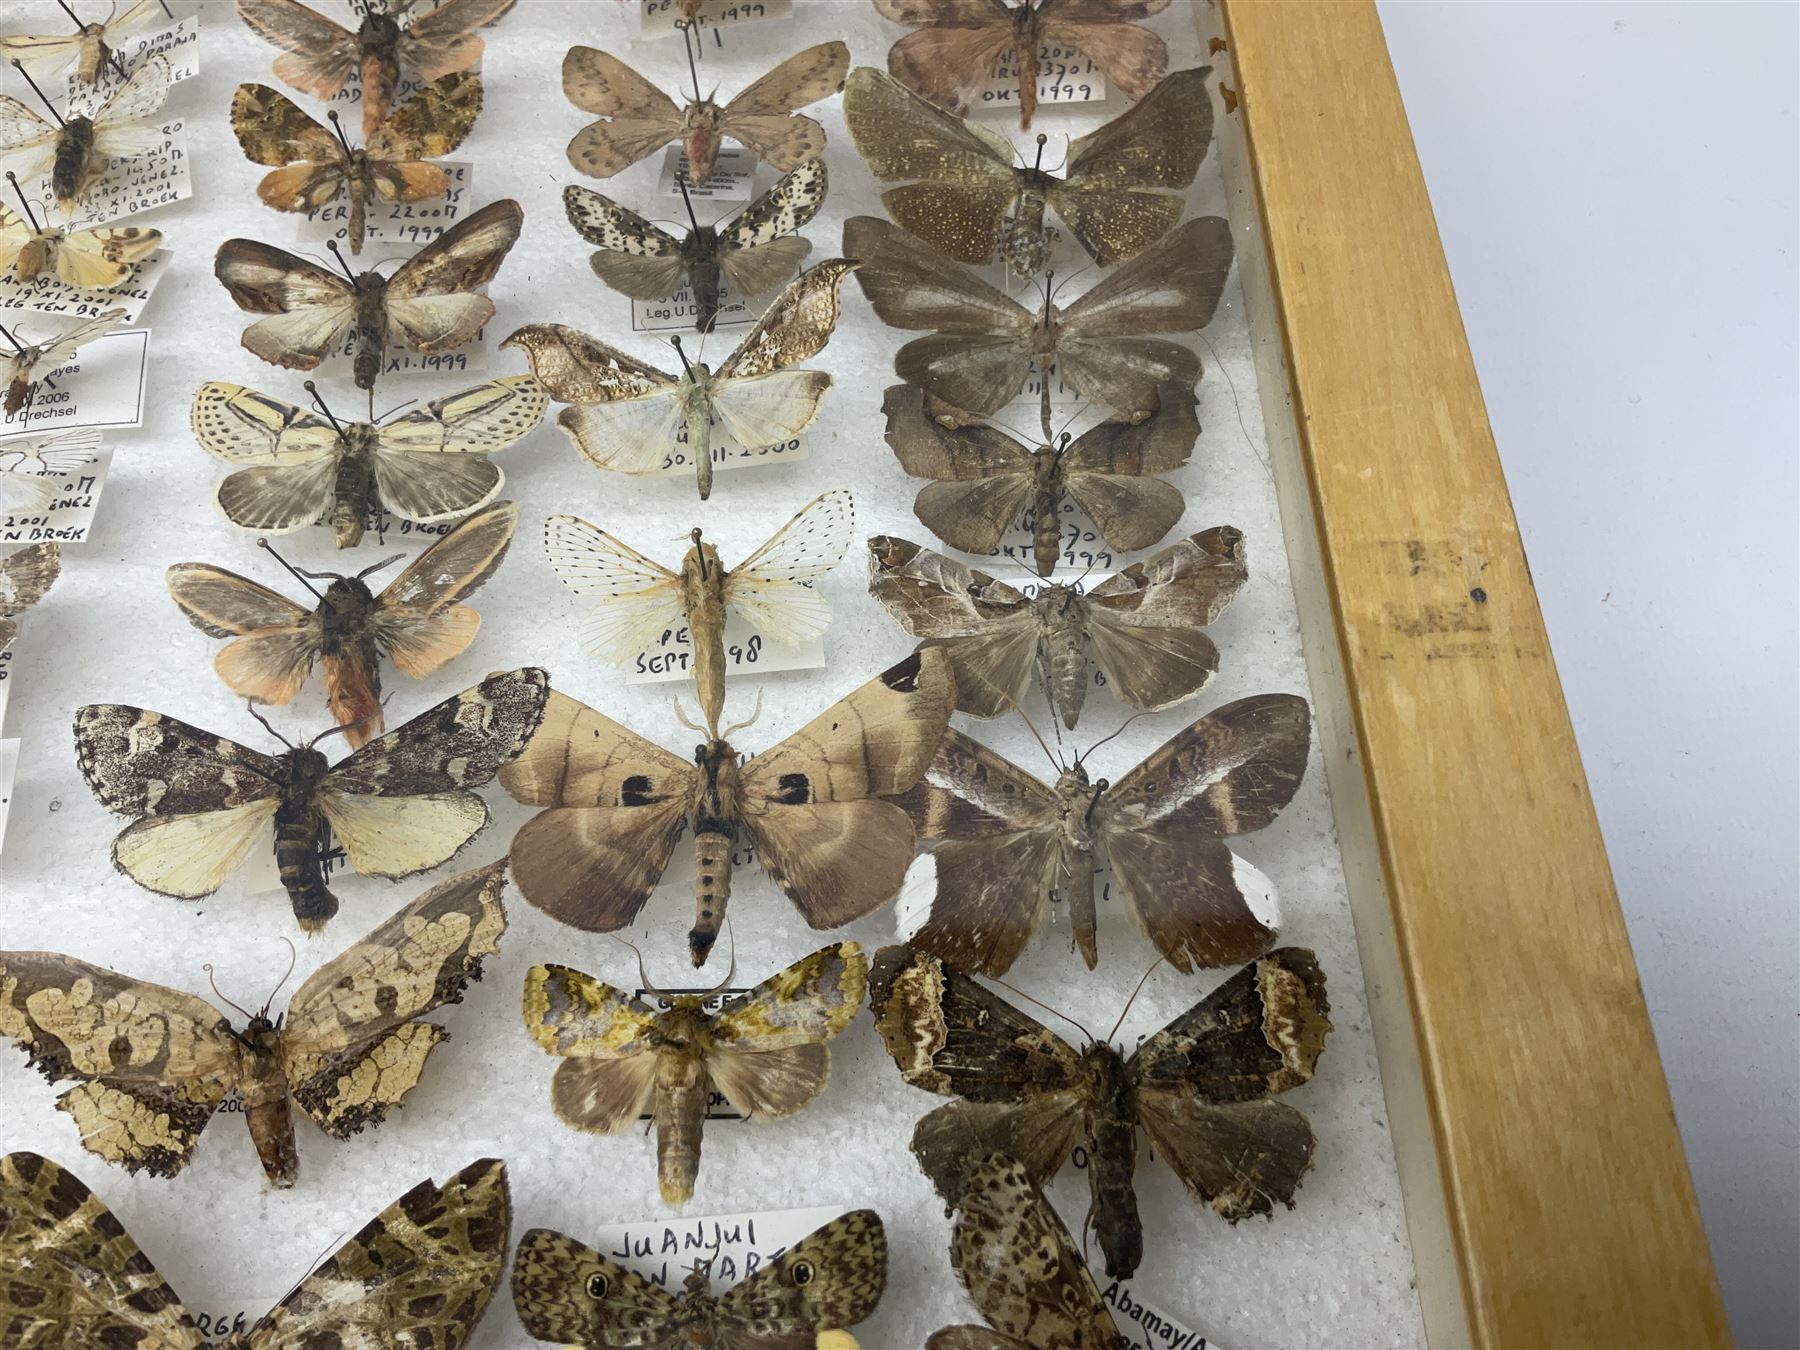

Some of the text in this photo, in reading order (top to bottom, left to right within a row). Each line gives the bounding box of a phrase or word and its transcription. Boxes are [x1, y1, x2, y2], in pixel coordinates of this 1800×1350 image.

[722, 4, 764, 20] 1999
[1041, 84, 1091, 100] 1999
[136, 182, 171, 197] 2001
[129, 191, 179, 213] BROEK
[32, 301, 68, 312] TEN
[5, 516, 49, 527] 2001
[29, 526, 86, 541] BROEK
[1063, 551, 1112, 569] 999
